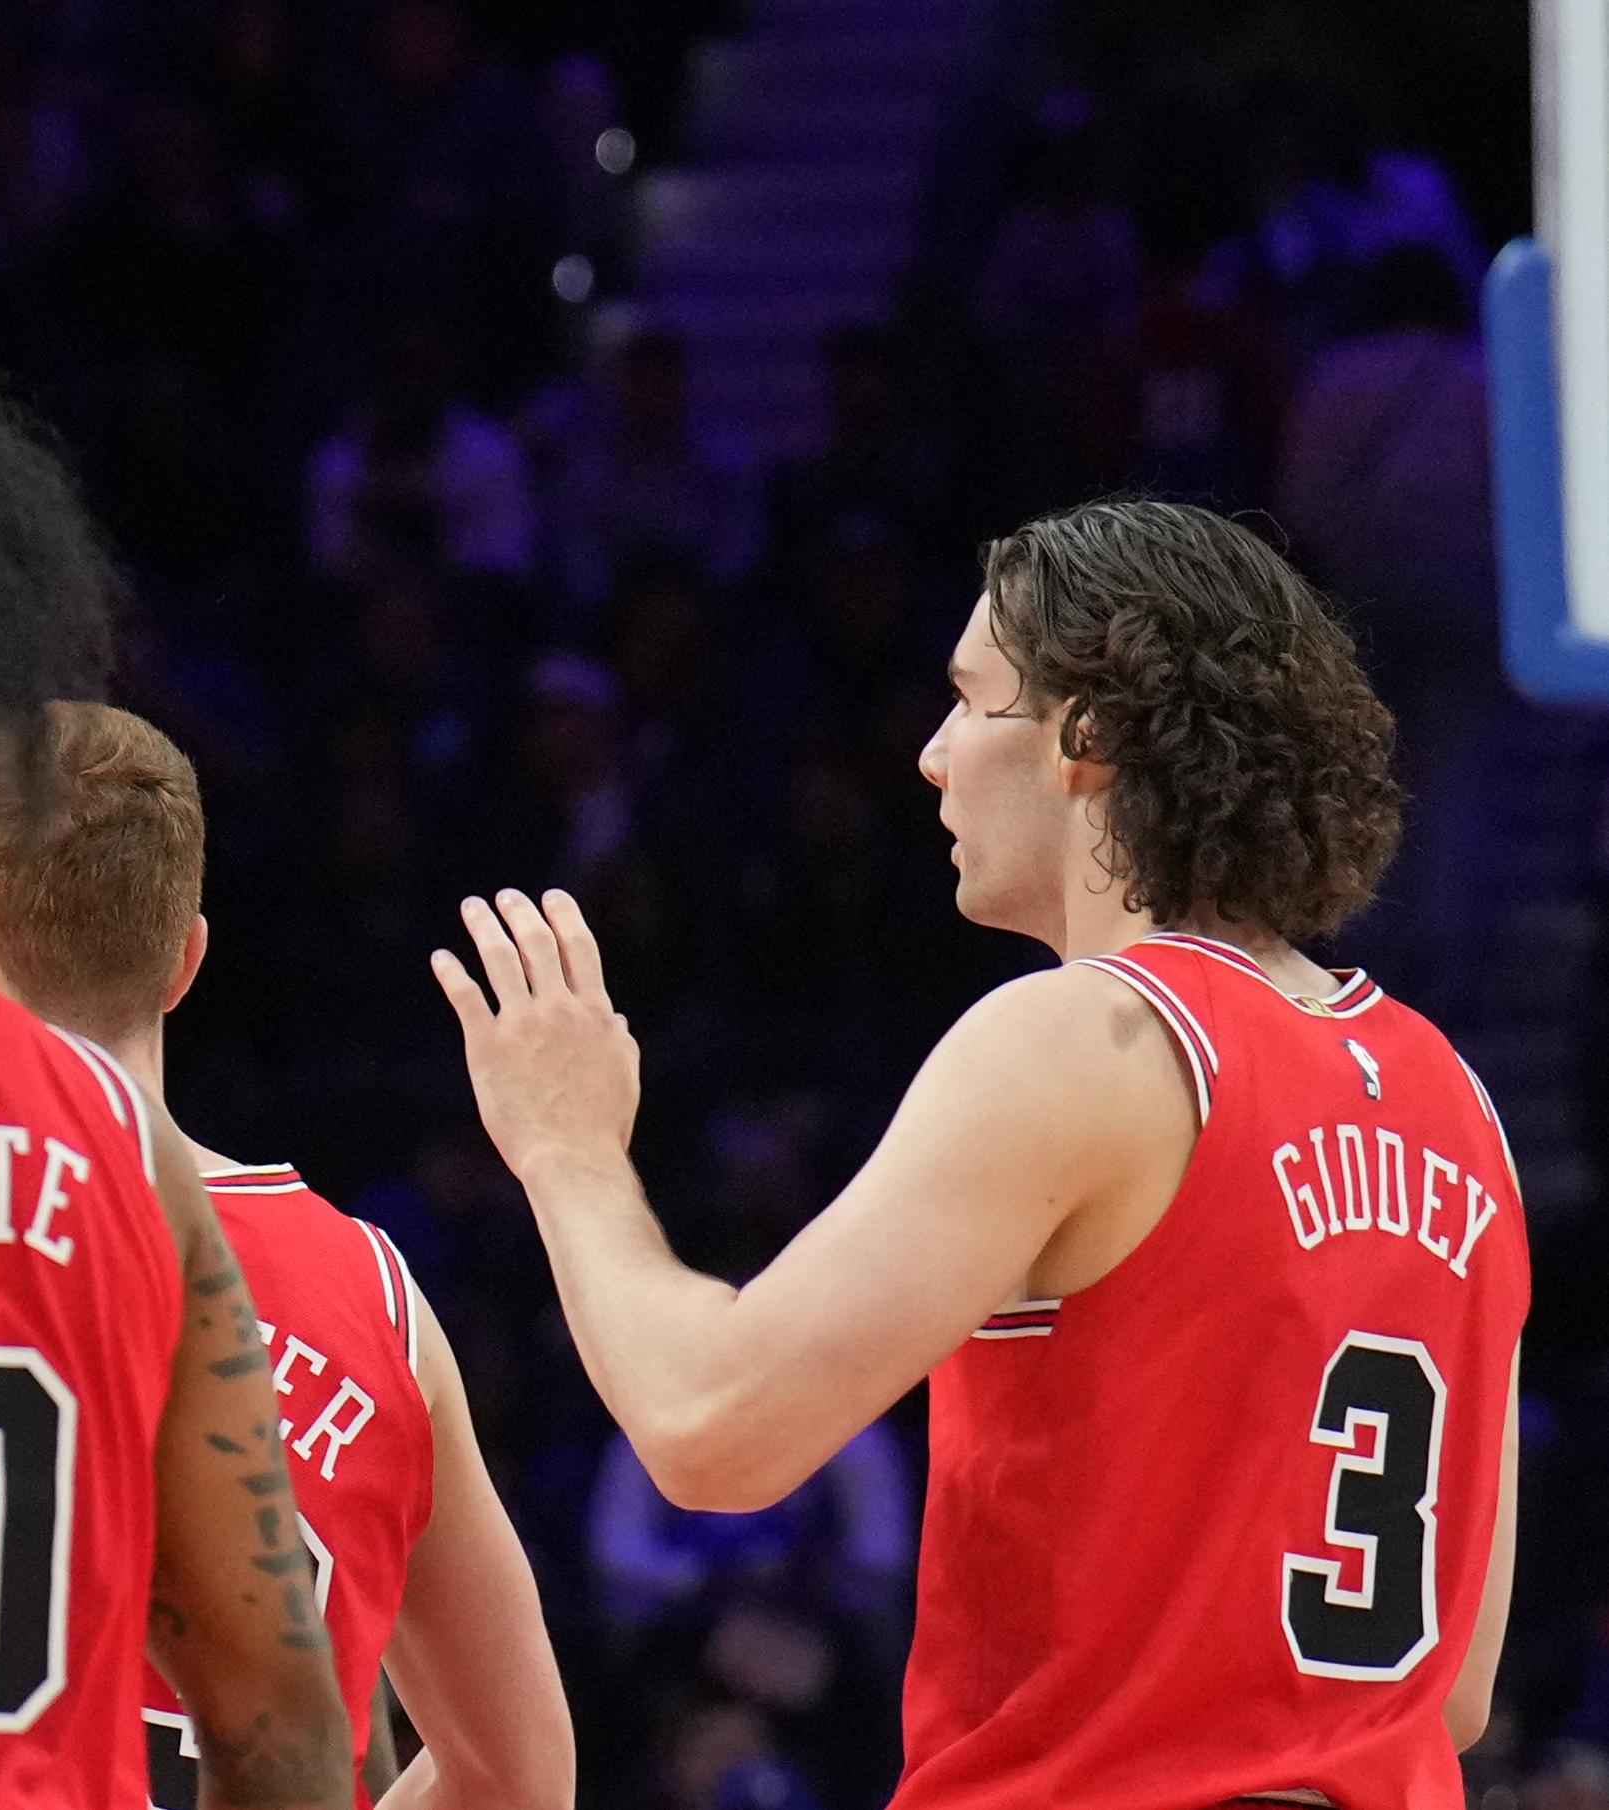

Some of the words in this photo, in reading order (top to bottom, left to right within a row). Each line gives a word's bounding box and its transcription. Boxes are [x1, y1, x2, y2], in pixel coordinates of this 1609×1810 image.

[1272, 1124, 1497, 1279] GIDDEY
[256, 1319, 376, 1482] ER
[1281, 1330, 1447, 1681] 3
